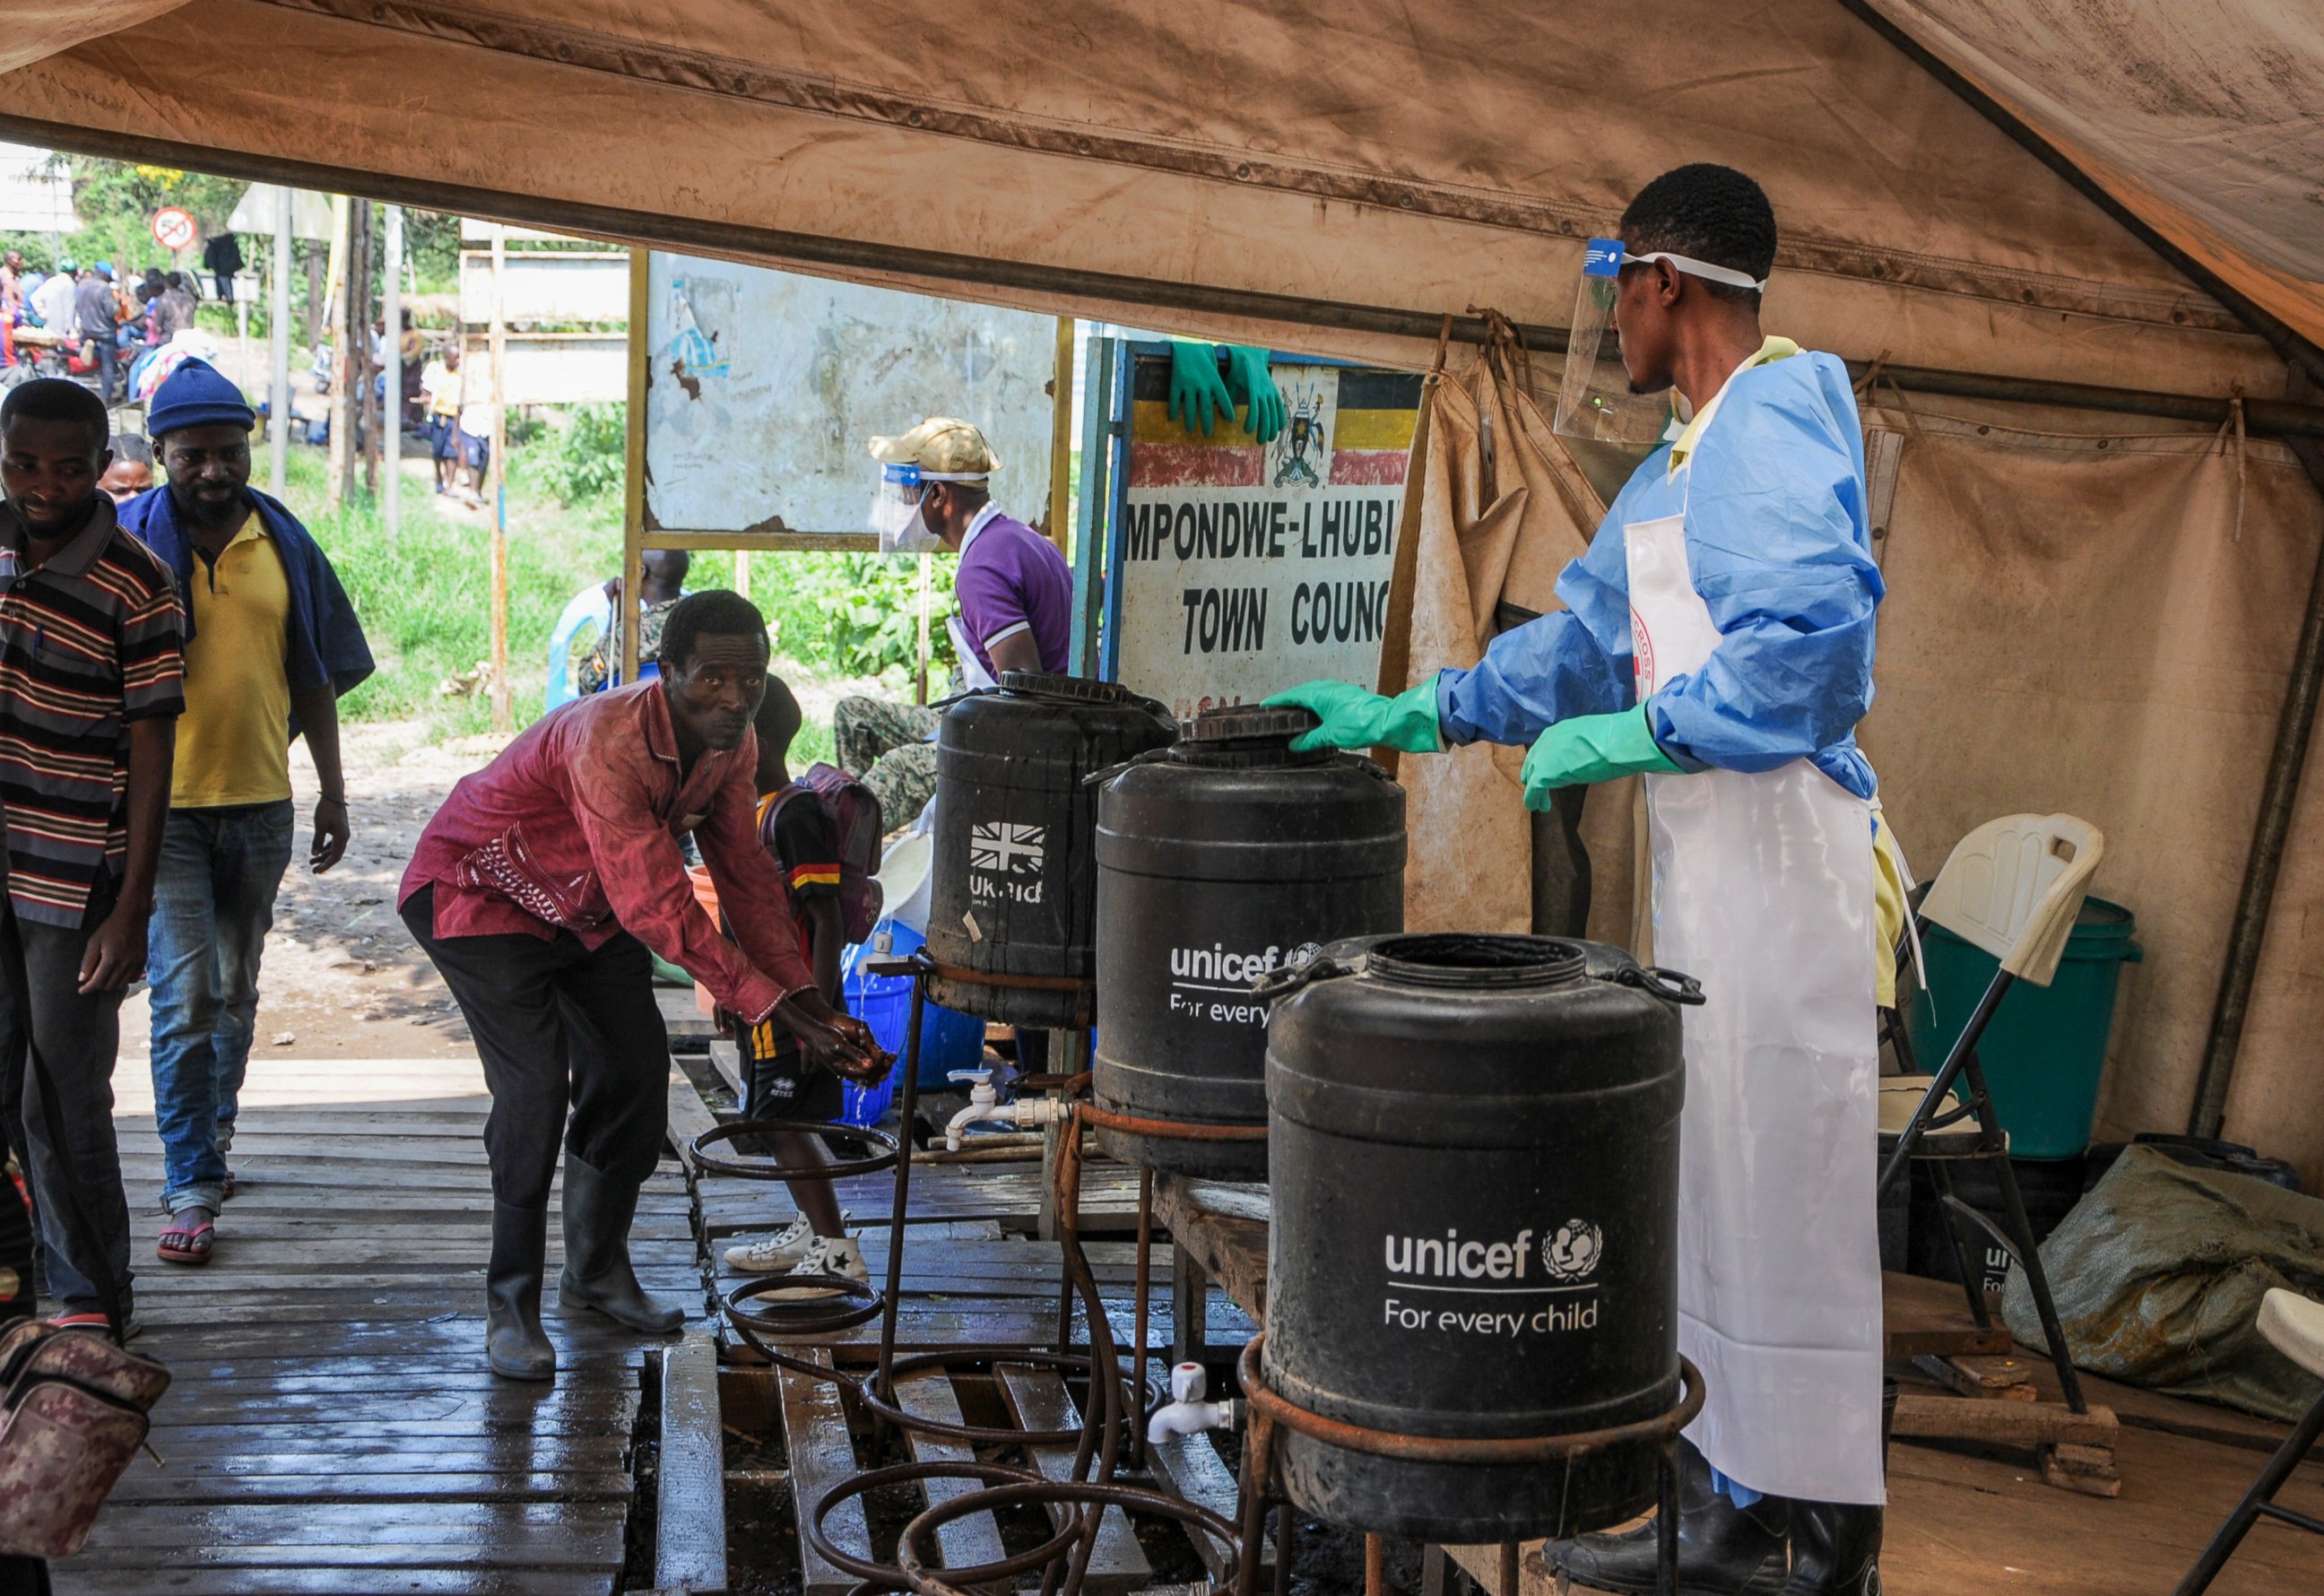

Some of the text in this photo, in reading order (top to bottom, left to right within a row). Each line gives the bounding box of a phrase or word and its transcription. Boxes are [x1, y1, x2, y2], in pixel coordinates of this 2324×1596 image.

[161, 219, 186, 238] 50
[1124, 499, 1401, 561] MPONDWE-LHUBI
[1183, 587, 1268, 655] TOWN
[1634, 620, 1652, 681] CROSS
[1171, 942, 1279, 983] unicef
[1210, 1003, 1270, 1029] every
[1385, 1228, 1532, 1279] unicef
[1385, 1298, 1598, 1339] For every child
